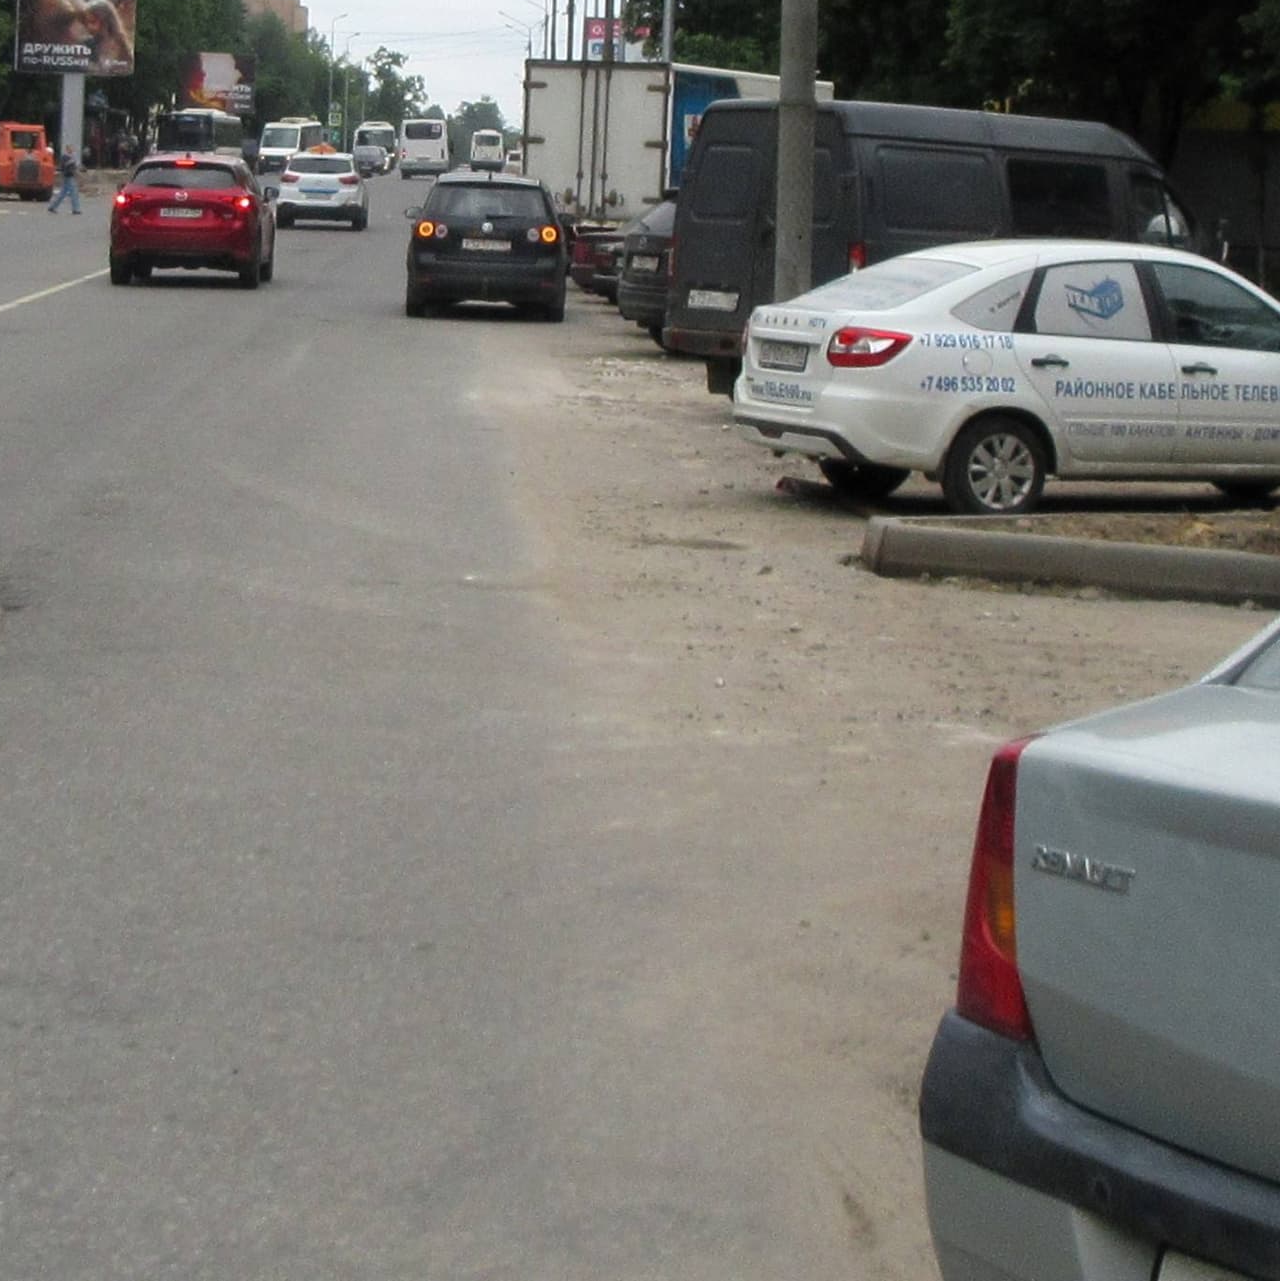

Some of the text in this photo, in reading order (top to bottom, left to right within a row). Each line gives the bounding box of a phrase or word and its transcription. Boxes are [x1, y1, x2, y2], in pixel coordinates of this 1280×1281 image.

[23, 43, 92, 55] ДРУЖИТЬ
[935, 376, 958, 391] 496
[961, 376, 983, 391] 535
[1056, 378, 1134, 399] РАЙОННОЕ
[1186, 426, 1242, 438] АНТЕННЫ
